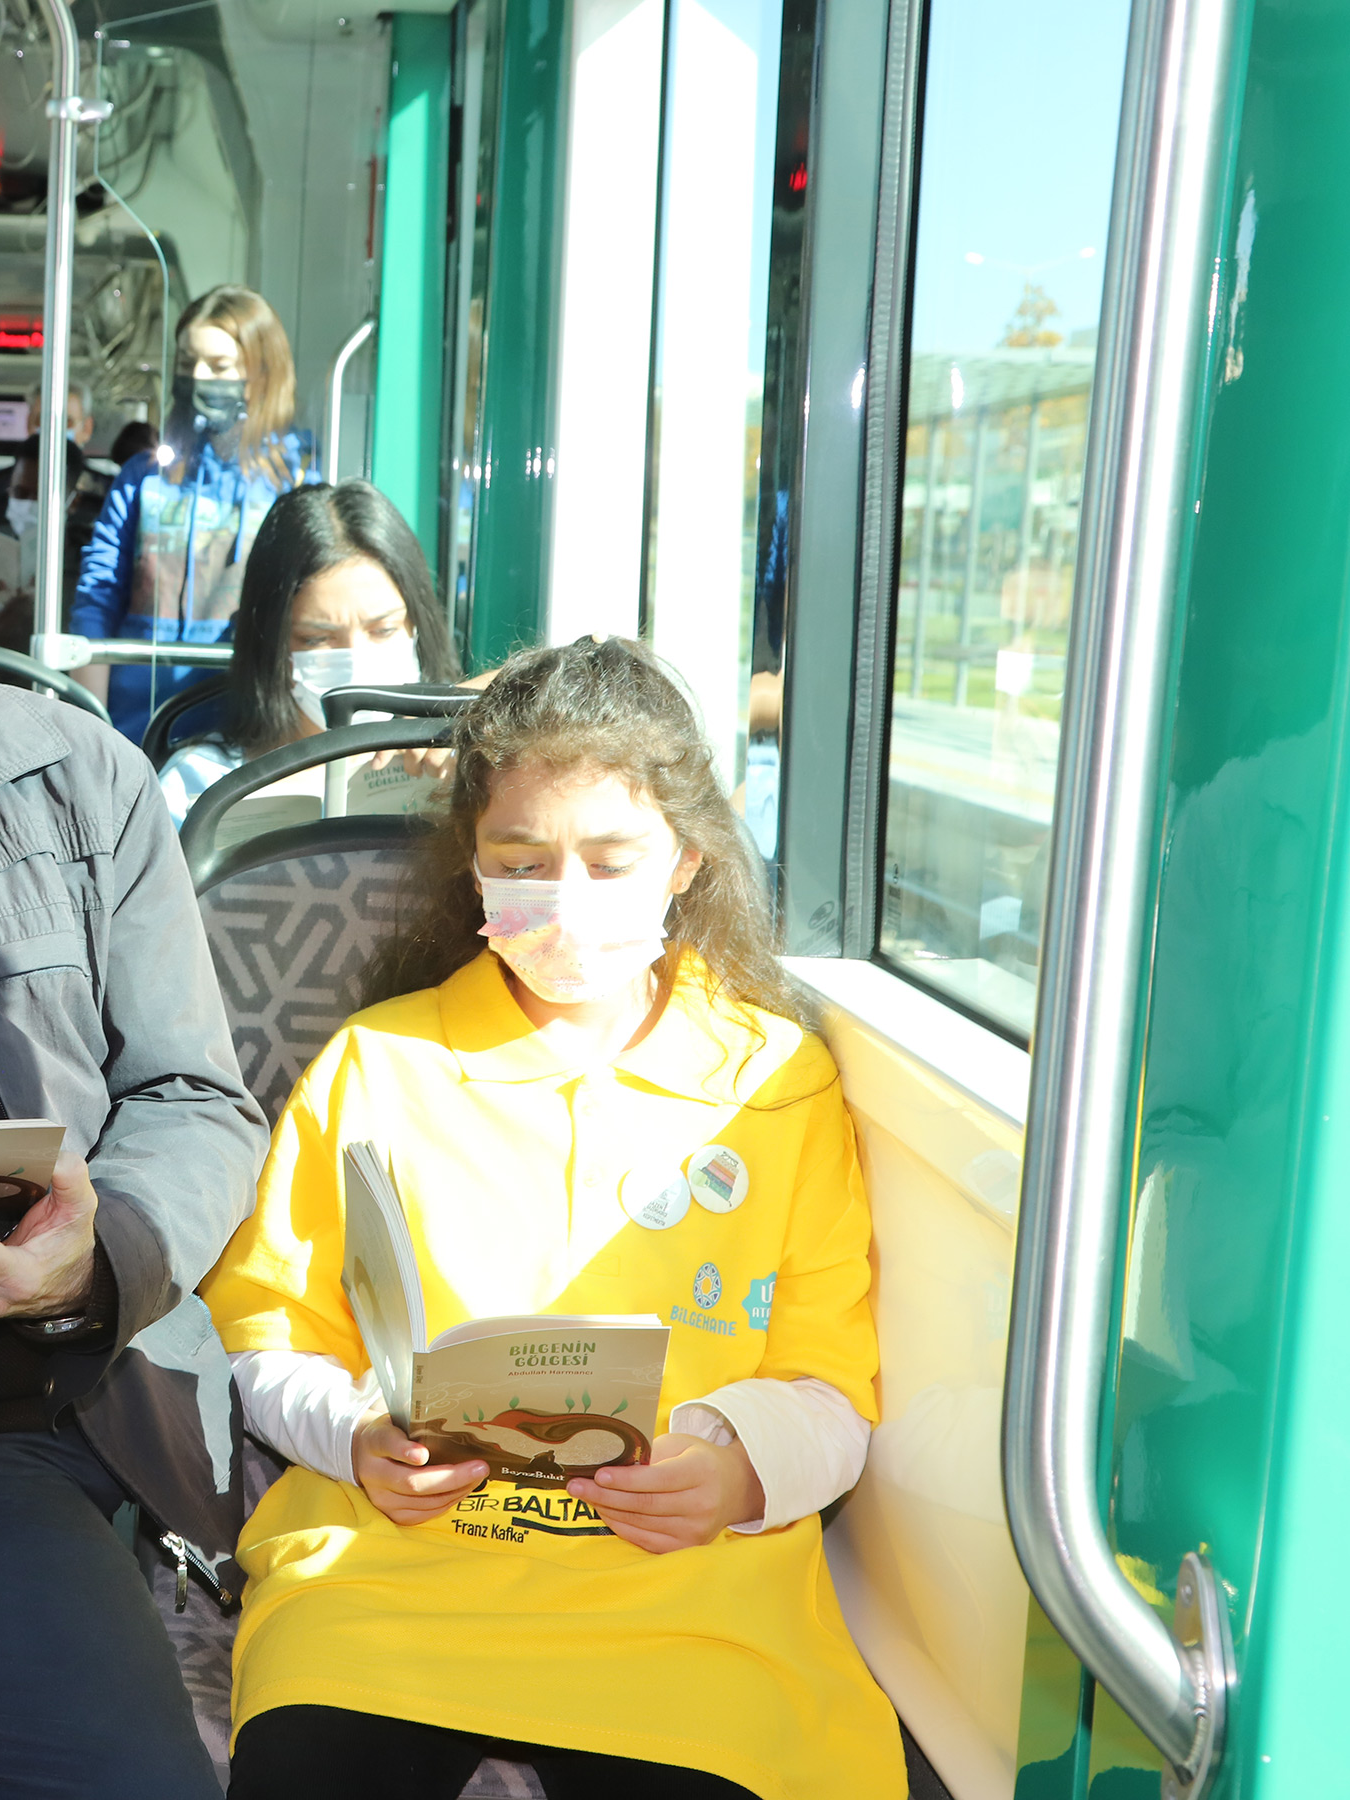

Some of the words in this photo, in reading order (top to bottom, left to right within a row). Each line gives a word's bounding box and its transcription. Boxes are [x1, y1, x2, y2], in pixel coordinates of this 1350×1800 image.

[509, 1340, 596, 1356] BİLGENİN
[514, 1352, 588, 1367] GÖLGESİ
[507, 1369, 547, 1377] Abdullah
[503, 1495, 602, 1521] BALTA
